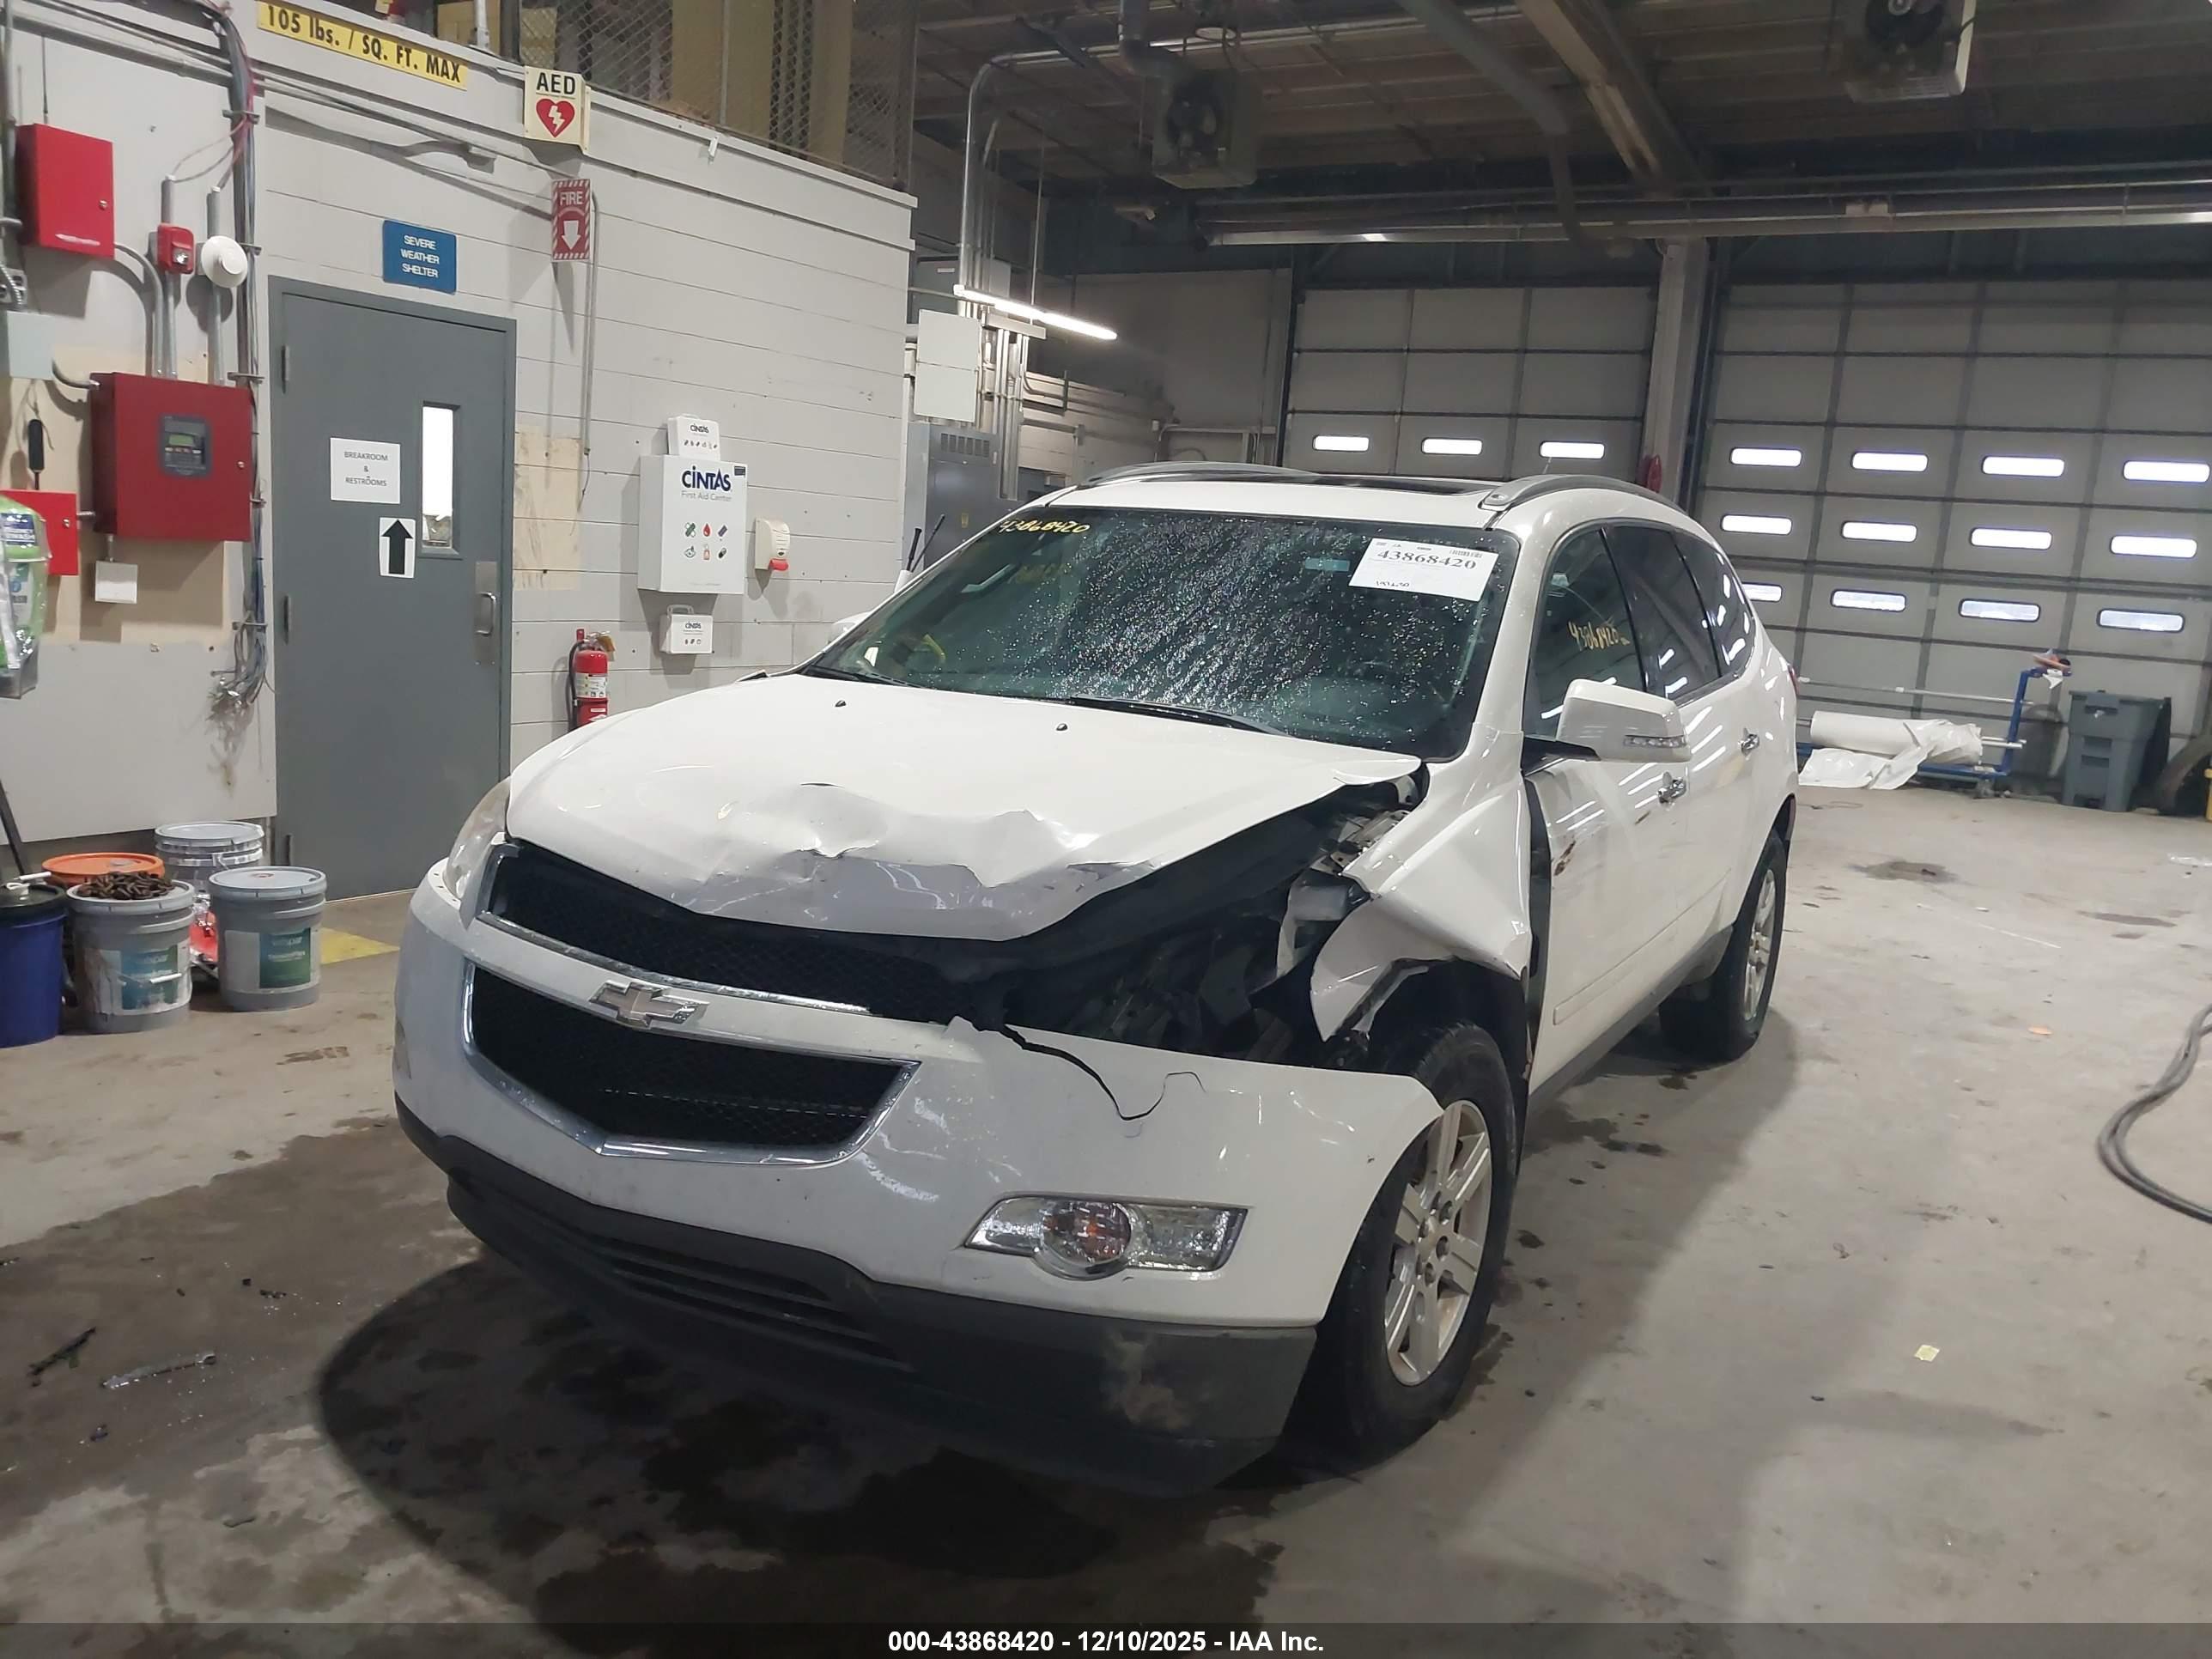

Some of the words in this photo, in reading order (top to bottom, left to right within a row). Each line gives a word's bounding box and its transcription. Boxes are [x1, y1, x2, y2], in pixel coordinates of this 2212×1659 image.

[268, 5, 301, 33] 105
[309, 15, 339, 46] lbs.
[349, 30, 355, 50] /
[362, 34, 388, 61] SQ.
[396, 46, 417, 70] FT.
[426, 55, 461, 83] MAX
[537, 72, 576, 95] AED
[560, 191, 583, 205] FIRE
[404, 234, 436, 251] SEVERE
[400, 248, 440, 264] WEATHER
[402, 263, 439, 278] SHELTER
[343, 451, 388, 461] BREAKROOM
[345, 477, 386, 486] RESTROOMS
[682, 465, 731, 492] CINTAS
[681, 489, 696, 500] First
[697, 492, 708, 501] Aid
[1376, 549, 1477, 570] 43868420
